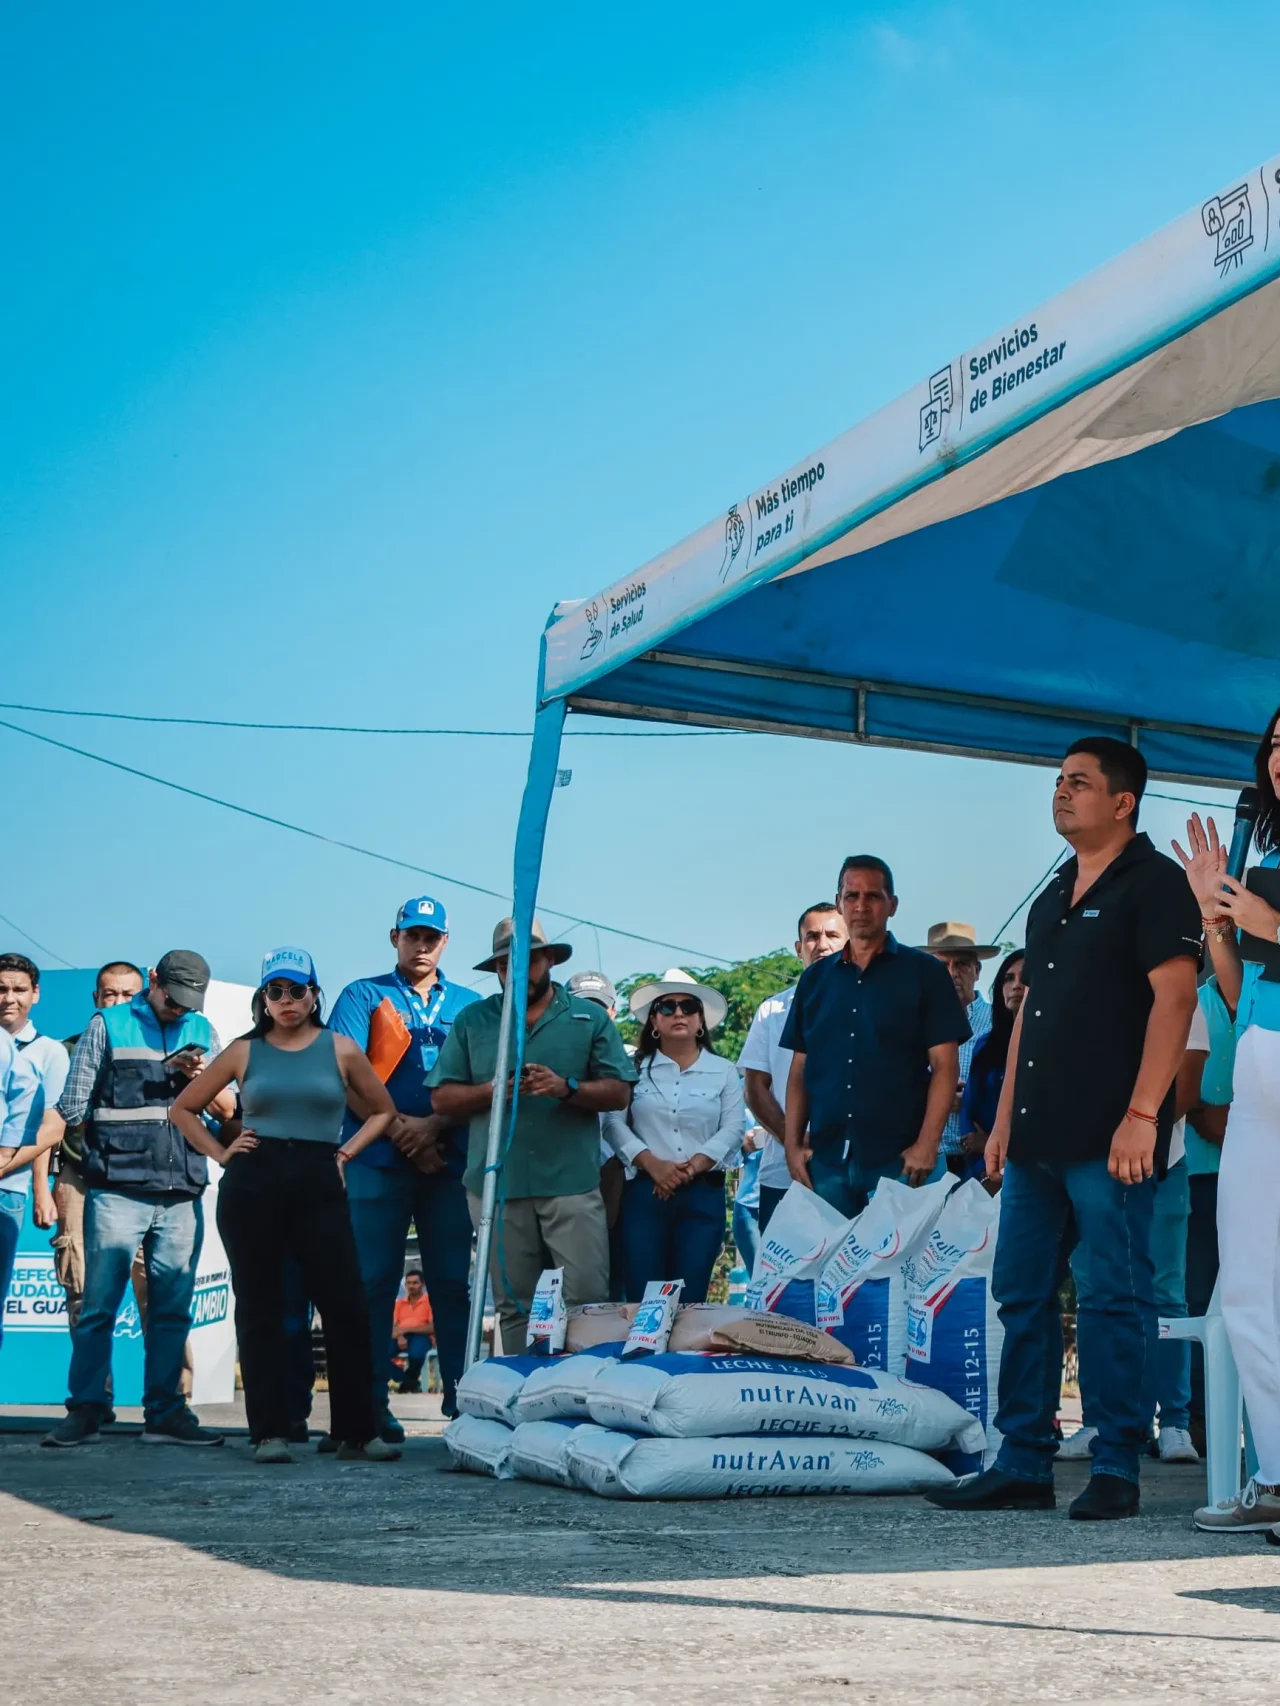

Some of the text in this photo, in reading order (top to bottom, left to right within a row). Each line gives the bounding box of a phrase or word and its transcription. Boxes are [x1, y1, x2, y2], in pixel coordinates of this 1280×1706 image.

[969, 323, 1038, 381] Servicios
[969, 340, 1067, 414] de Bienestar
[755, 462, 825, 520] Más tiempo
[755, 509, 794, 557] para ti
[610, 582, 647, 615] Servicios
[610, 604, 644, 639] de Salud
[765, 1329, 789, 1339] TRIUNFO
[712, 1360, 829, 1380] LECHE 12-15
[964, 1327, 980, 1380] 12-15
[740, 1385, 857, 1412] nutrAvan
[758, 1418, 820, 1432] LECHE
[712, 1450, 831, 1471] nutrAvan
[725, 1484, 791, 1496] LECHE
